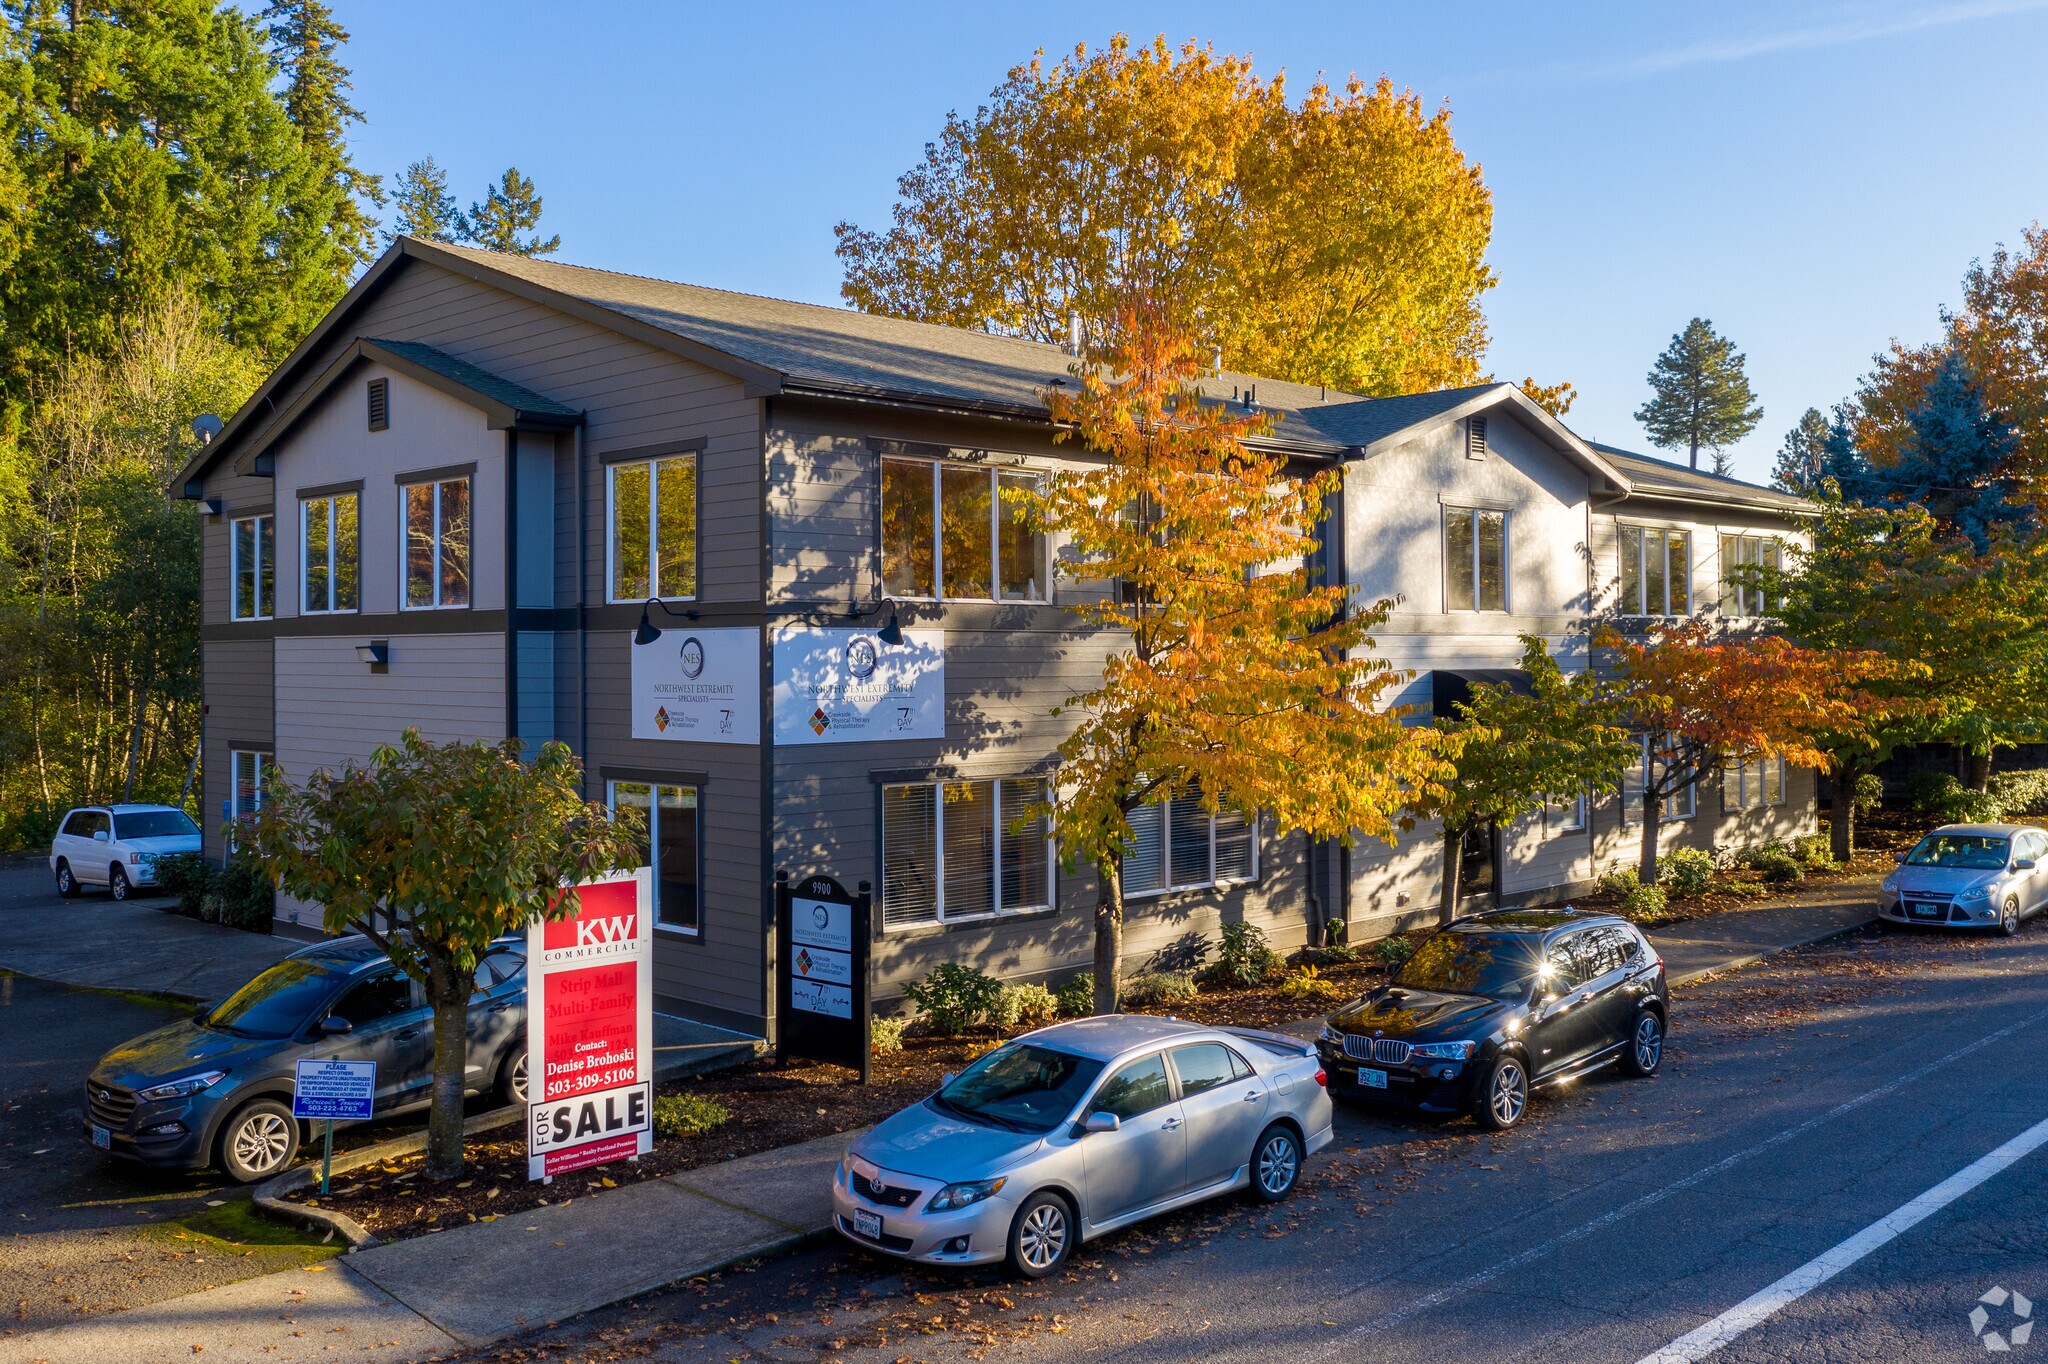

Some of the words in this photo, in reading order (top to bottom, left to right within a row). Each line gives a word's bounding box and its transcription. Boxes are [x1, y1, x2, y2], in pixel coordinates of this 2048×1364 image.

[684, 653, 700, 664] NES
[851, 652, 872, 664] NES
[654, 684, 695, 694] NORTHWEST
[696, 684, 735, 694] EXTREMITY
[808, 684, 865, 694] NORTHWEST
[867, 683, 914, 693] EXTREMITY
[677, 695, 709, 703] SPECIALISTS
[842, 695, 883, 703] SPECIALISTS
[720, 709, 736, 721] 7th
[897, 707, 916, 719] 7th
[720, 720, 733, 730] DAY
[833, 722, 866, 730] Rehabilitation
[852, 716, 871, 724] Therapy
[897, 718, 913, 727] DAY
[812, 881, 831, 896] 9900
[815, 914, 826, 922] NES
[576, 914, 636, 947] KW
[795, 929, 822, 938] NORTHWEST
[822, 932, 847, 942] EXTREMITY
[545, 942, 636, 961] COMMERCIAL
[811, 953, 830, 962] Creekside
[814, 960, 830, 968] Physical
[830, 962, 847, 972] Therapy
[560, 978, 592, 995] Strip
[594, 971, 623, 989] Mall
[811, 982, 830, 997] 7th
[549, 992, 634, 1018] Multi-Family
[811, 995, 827, 1007] DAY
[549, 1032, 577, 1047] Mike
[580, 1024, 633, 1041] Kauffman
[575, 1039, 608, 1053] Contact:
[325, 1063, 347, 1071] PLEASE
[547, 1059, 585, 1076] Denise
[586, 1048, 635, 1069] Brohoski
[547, 1066, 635, 1097] 503-309-5106
[1360, 1071, 1371, 1082] 352
[301, 1097, 336, 1105] Retriever
[337, 1099, 365, 1107] Towing
[551, 1091, 645, 1143] SALE
[536, 1110, 550, 1146] FOR
[546, 1156, 560, 1165] Keller
[582, 1148, 597, 1157] Realty
[597, 1144, 616, 1152] Portland
[616, 1140, 636, 1148] Premiere
[547, 1166, 557, 1174] Each
[557, 1164, 568, 1172] Office
[572, 1158, 597, 1168] Independently
[597, 1153, 611, 1162] Owned
[855, 1217, 879, 1236] 7NPP048
